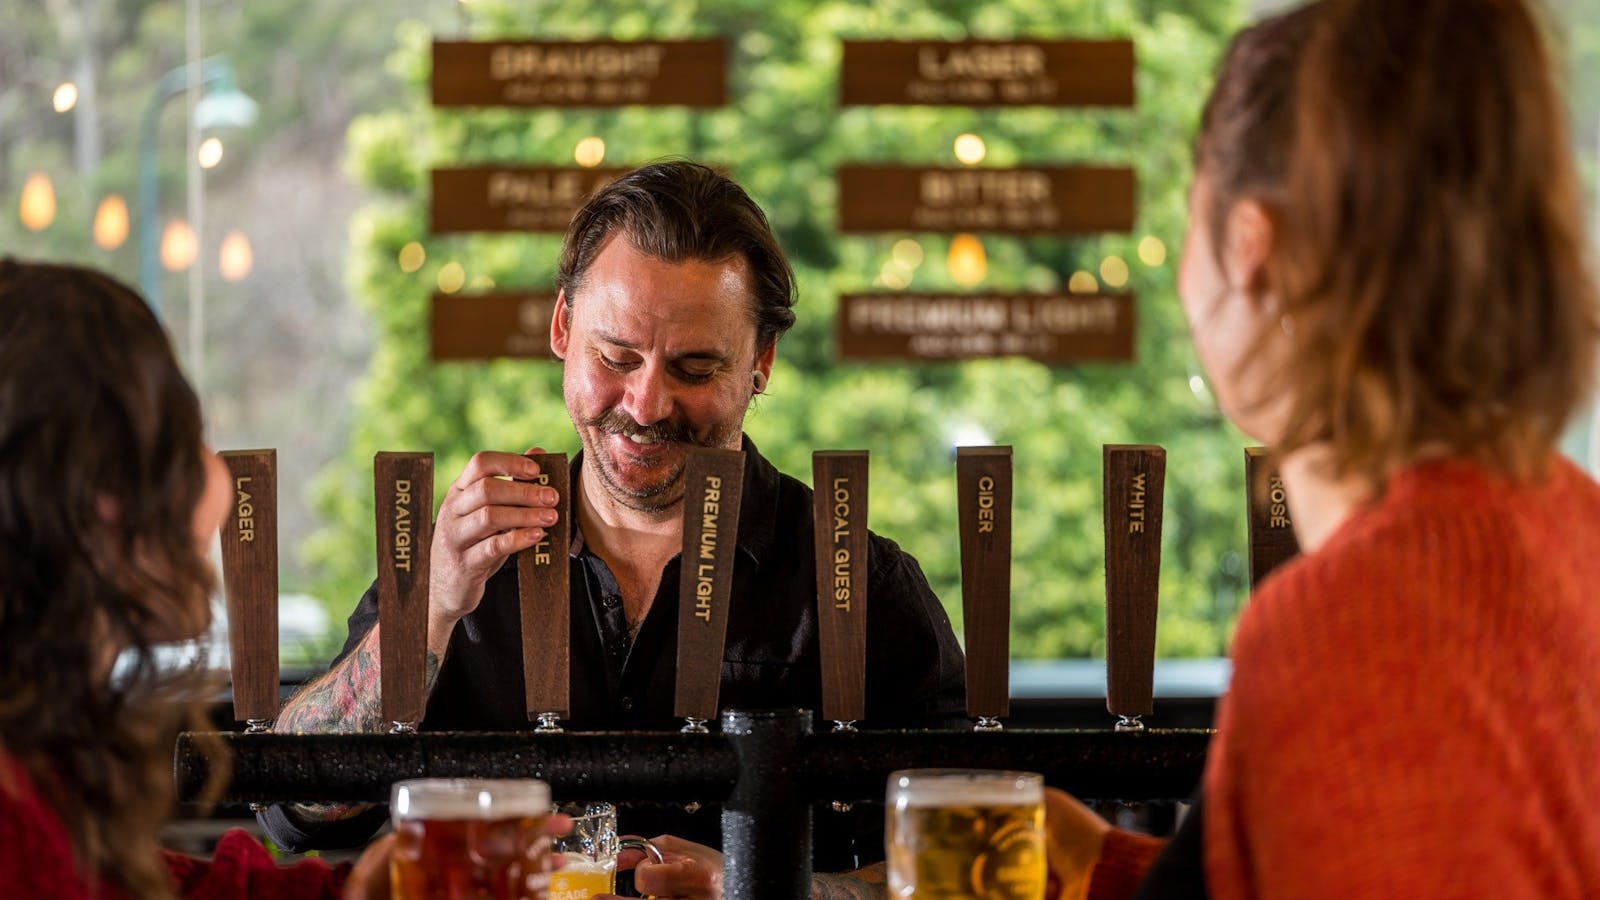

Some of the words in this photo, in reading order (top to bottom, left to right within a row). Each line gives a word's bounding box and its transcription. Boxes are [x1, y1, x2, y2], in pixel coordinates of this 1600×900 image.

[490, 45, 663, 79] DRAUGHT
[918, 45, 1046, 79] LAGER
[920, 170, 1051, 206] BITTER
[849, 297, 1006, 333] PREMIUM
[1010, 297, 1118, 333] LIGHT
[235, 477, 254, 543] LAGER
[394, 480, 411, 572] DRAUGHT
[699, 476, 722, 559] PREMIUM
[832, 478, 850, 544] LOCAL
[977, 476, 994, 535] CIDER
[1129, 474, 1146, 535] WHITE
[694, 564, 714, 622] LIGHT
[835, 549, 851, 612] GUEST
